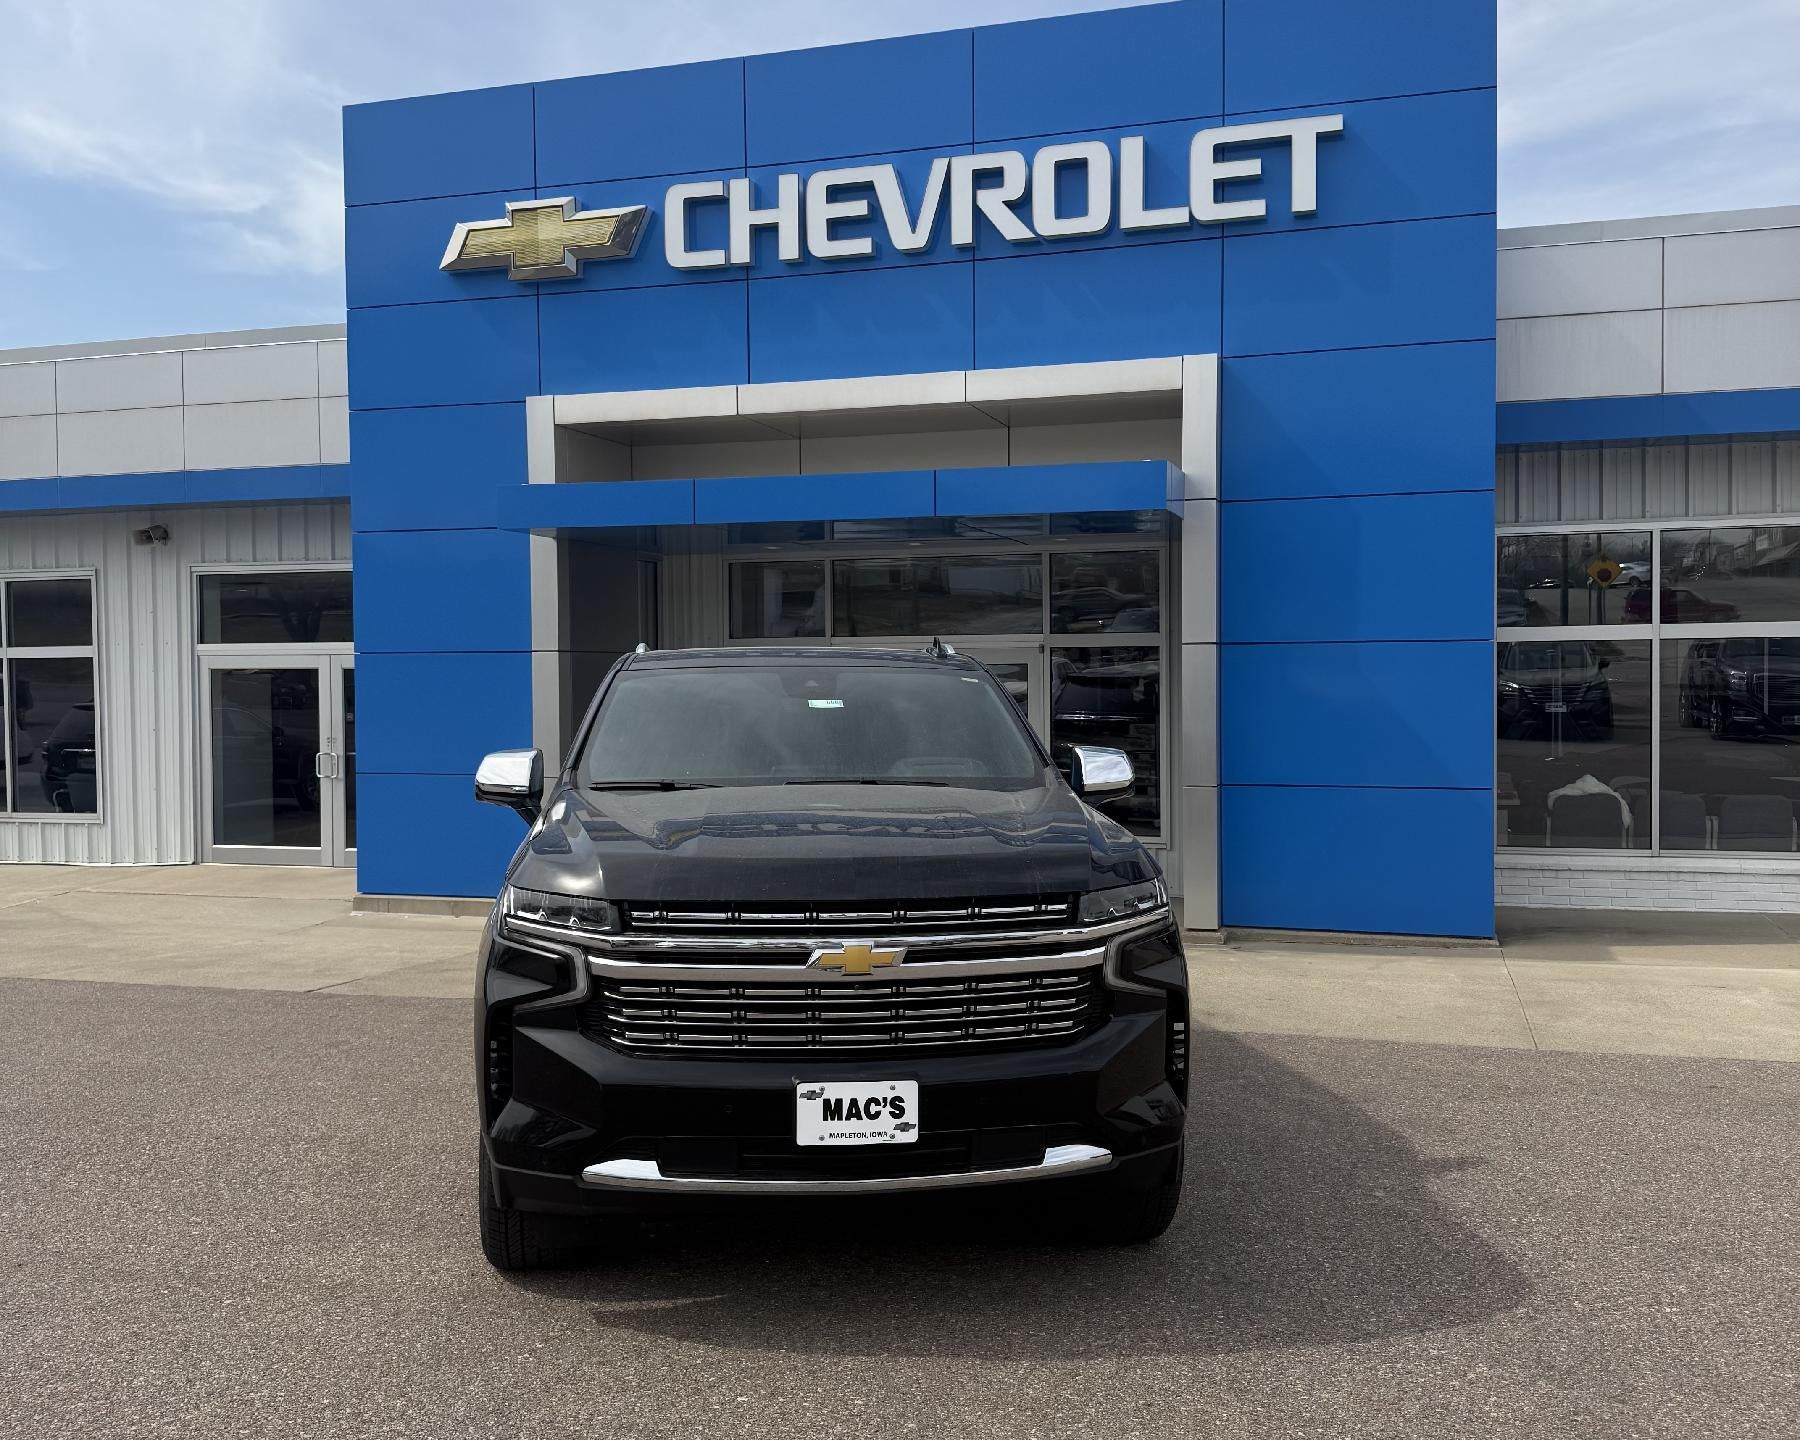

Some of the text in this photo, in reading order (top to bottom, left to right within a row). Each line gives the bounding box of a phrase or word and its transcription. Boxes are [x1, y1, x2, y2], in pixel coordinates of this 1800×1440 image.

[664, 114, 1344, 269] CHEVROLET
[822, 1095, 906, 1121] MAC'S
[828, 1131, 869, 1139] MAPLETON,
